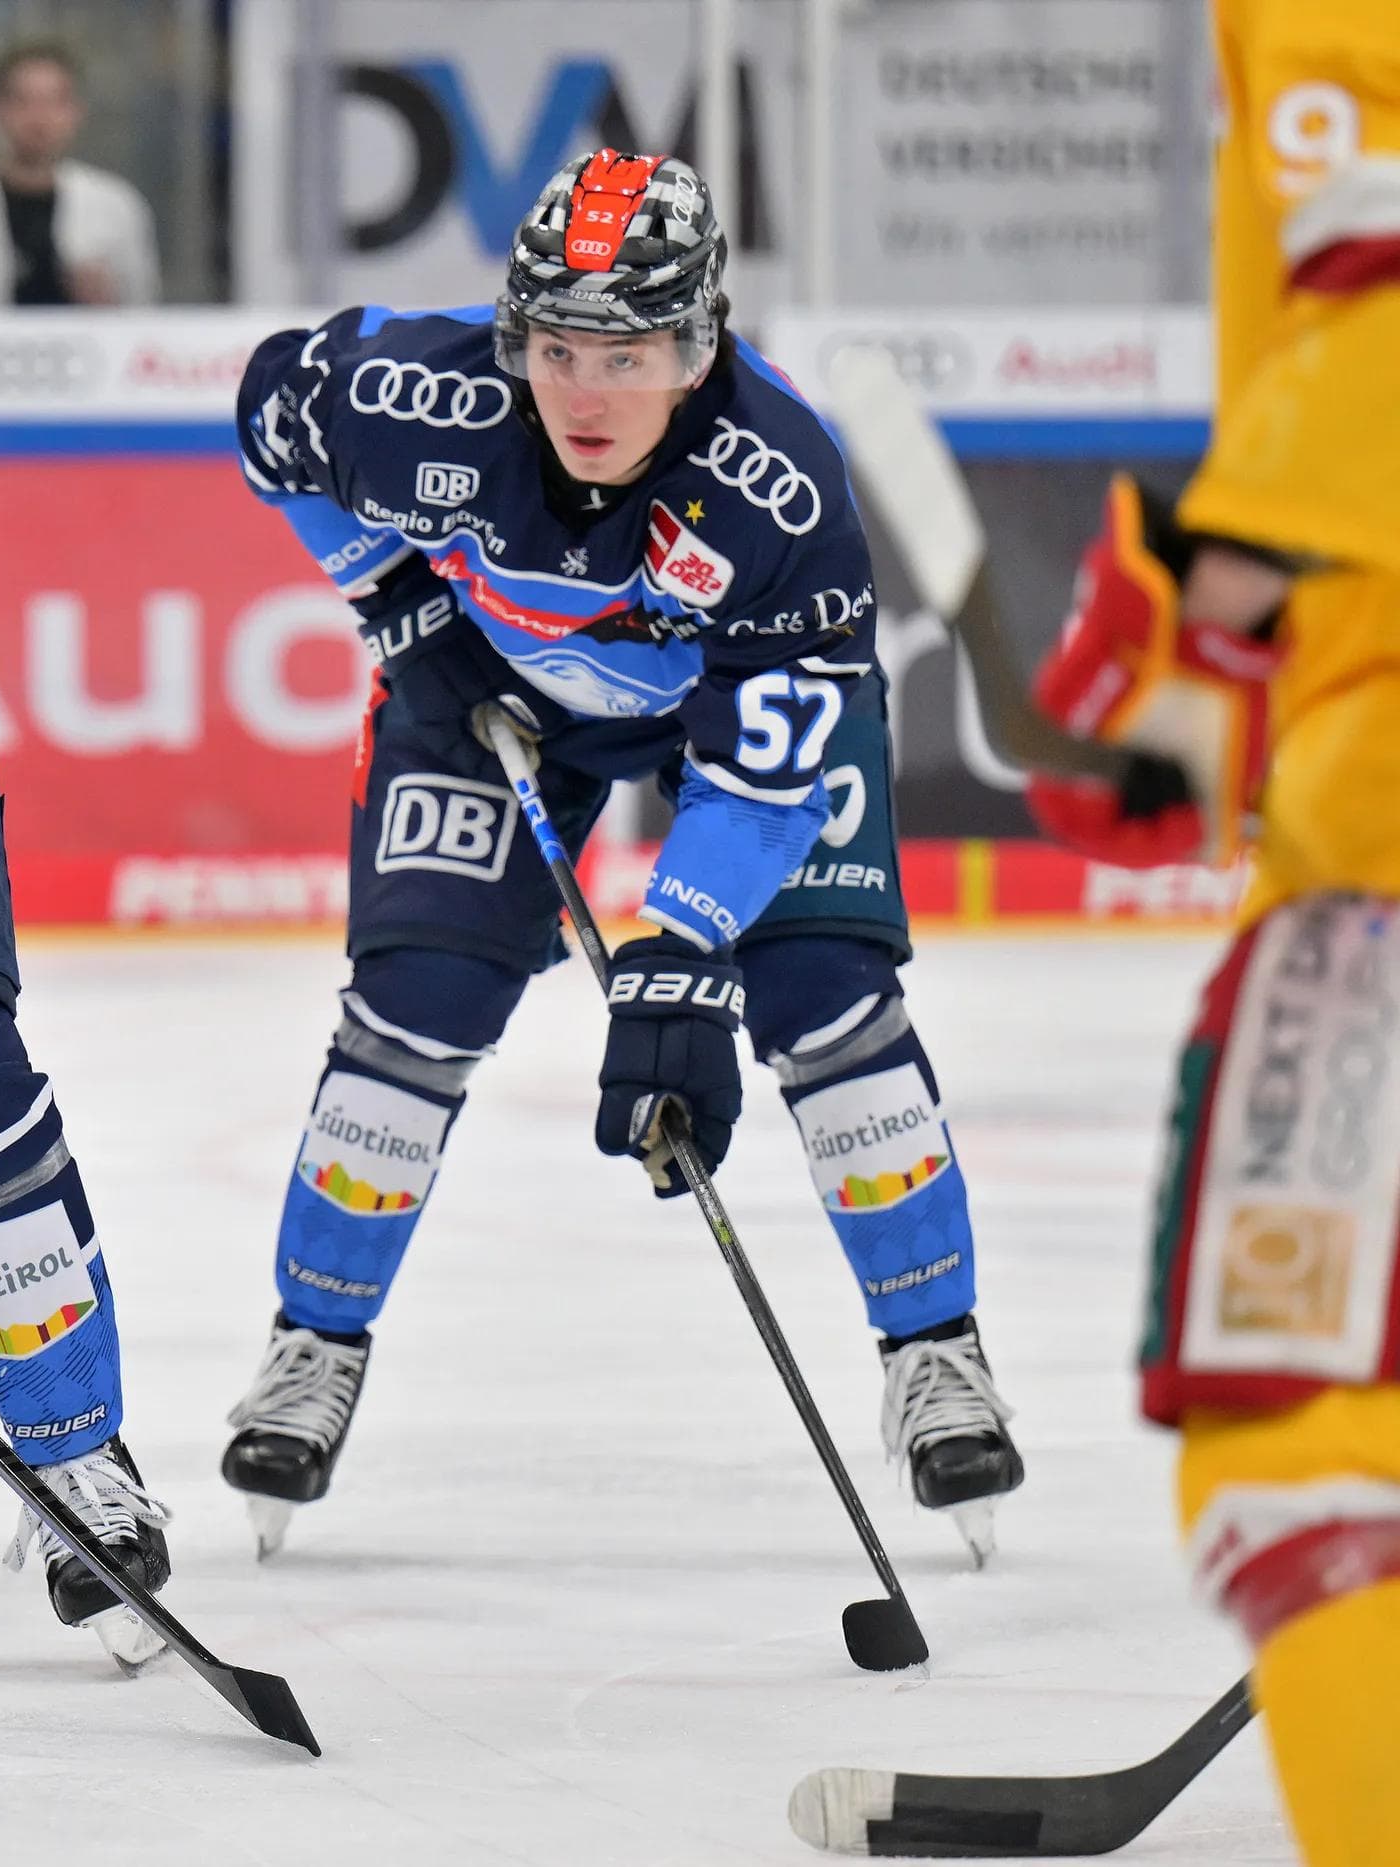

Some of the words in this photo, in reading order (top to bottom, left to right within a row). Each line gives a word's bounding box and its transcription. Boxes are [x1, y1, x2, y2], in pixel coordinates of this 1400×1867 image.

[586, 211, 614, 224] 52
[423, 469, 472, 501] DB
[364, 498, 434, 533] Regio
[387, 789, 497, 861] DB
[15, 1403, 107, 1438] BAUER
